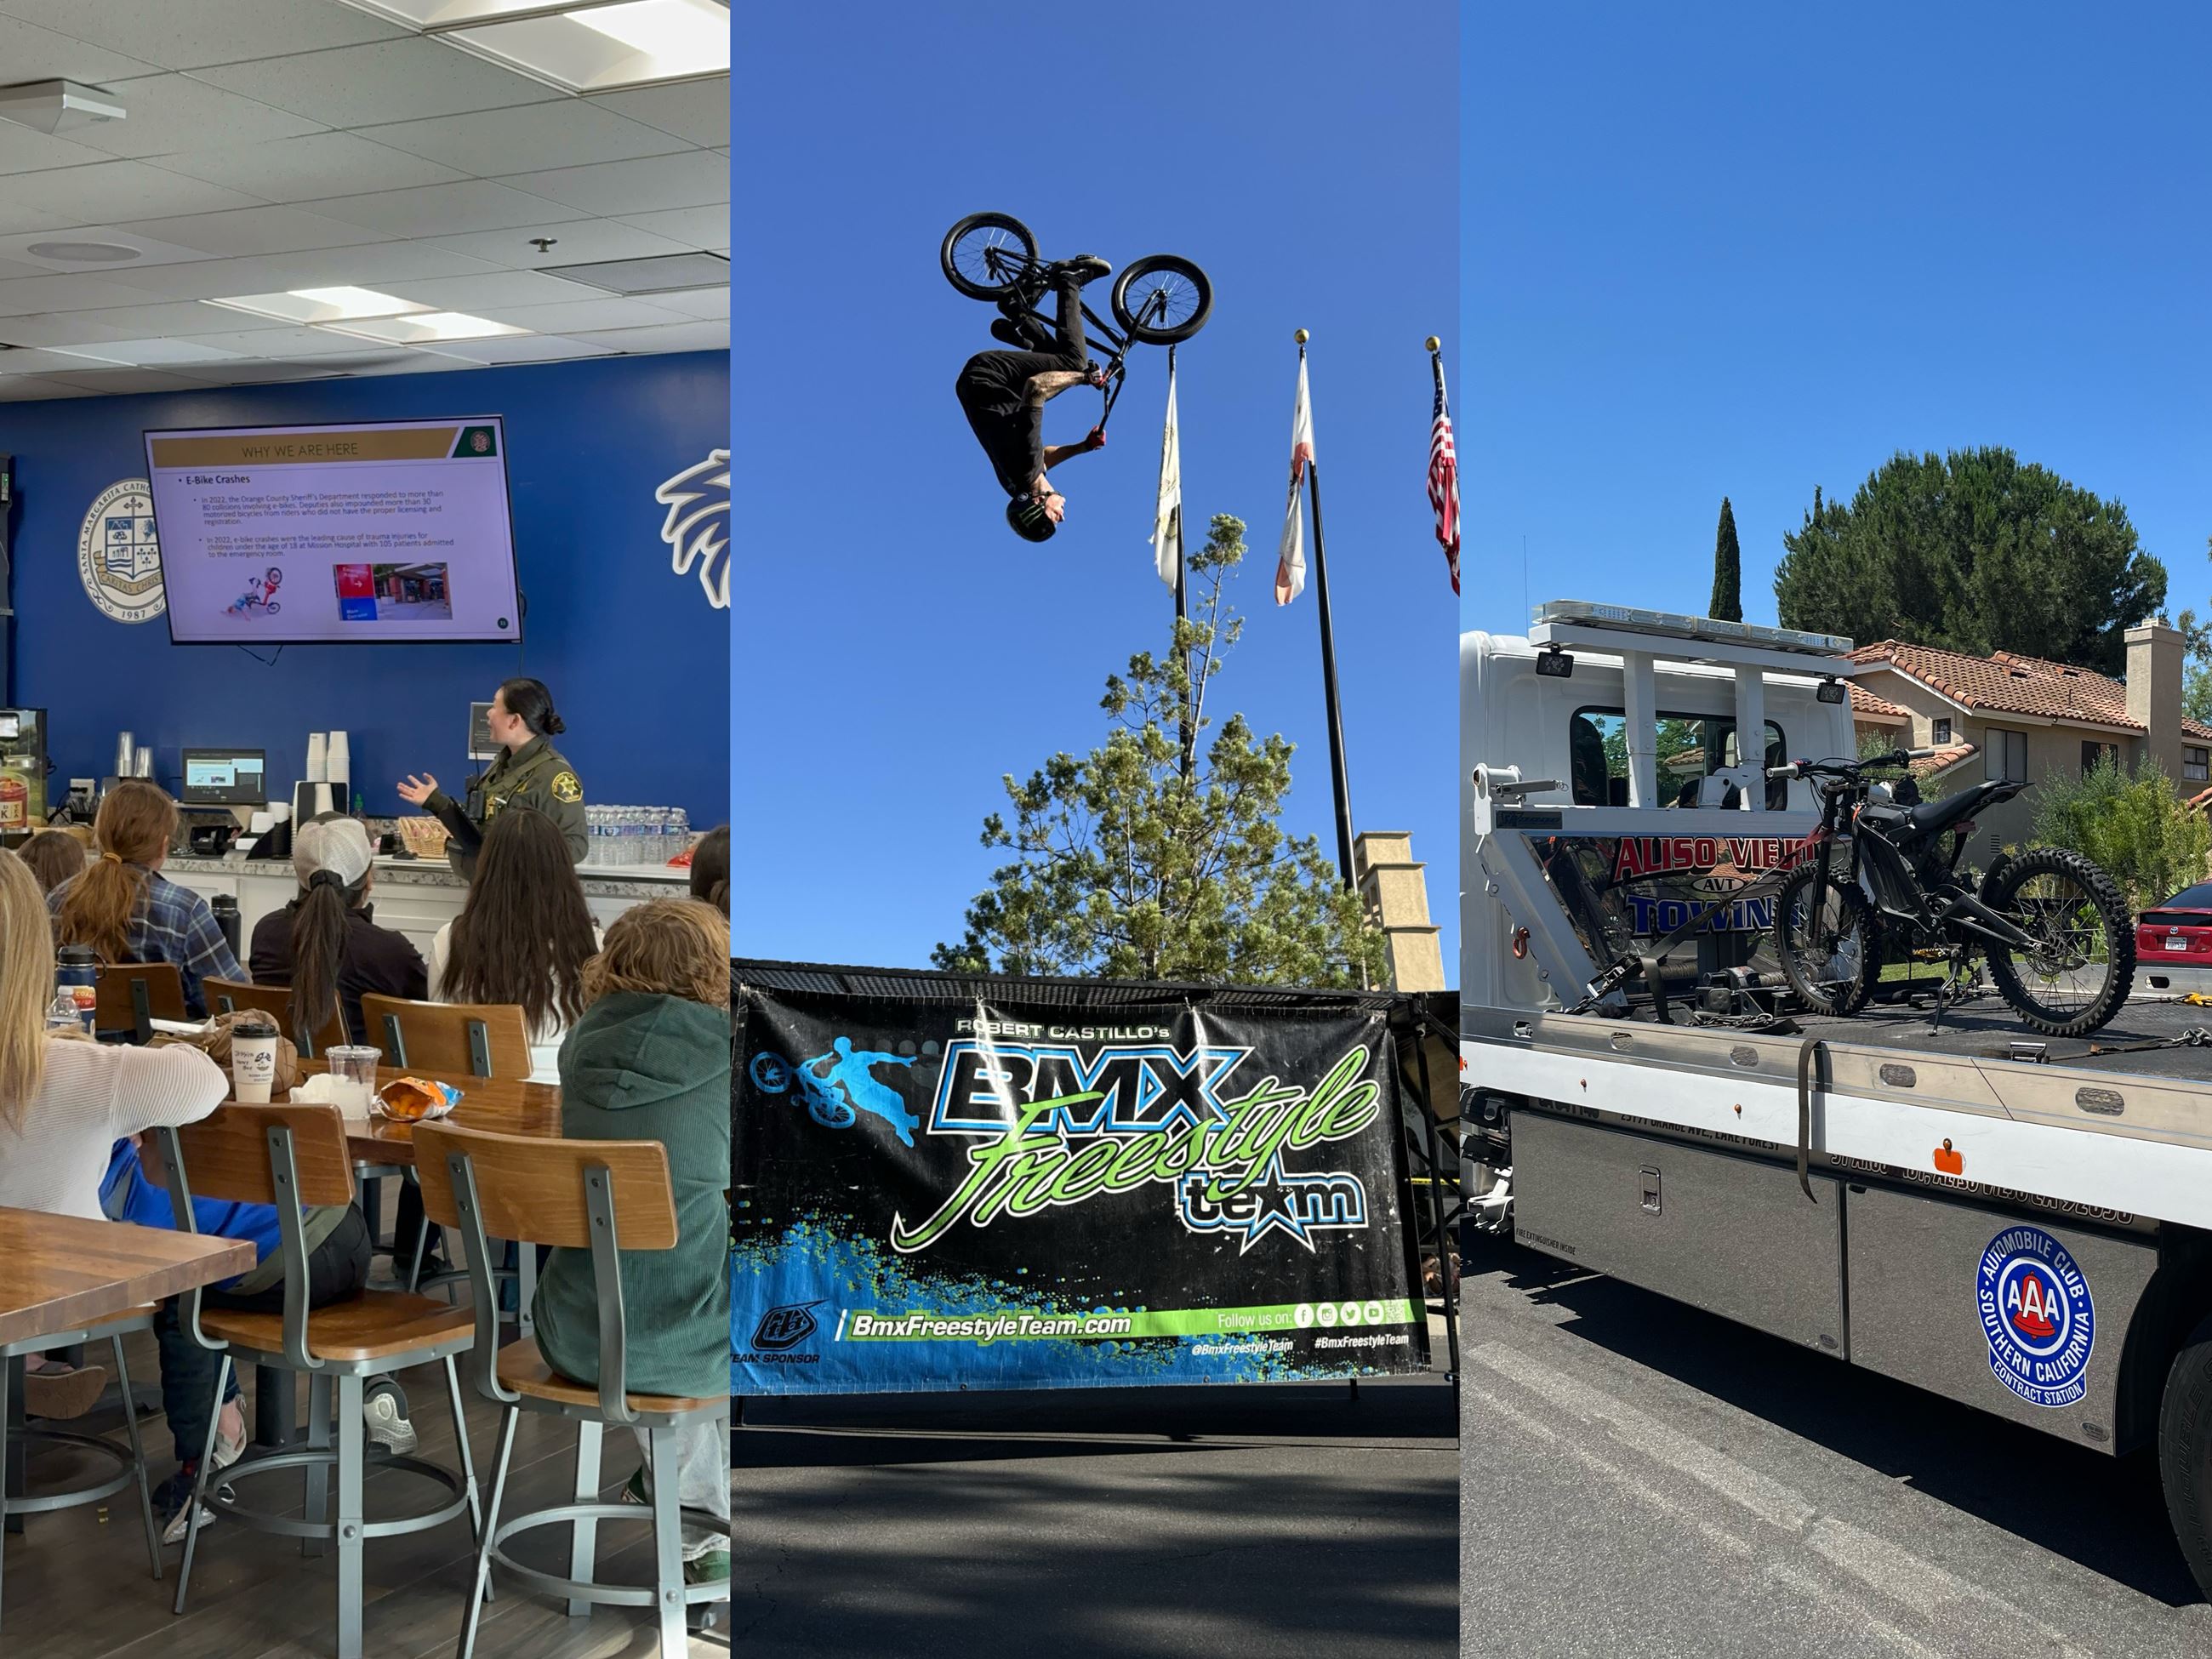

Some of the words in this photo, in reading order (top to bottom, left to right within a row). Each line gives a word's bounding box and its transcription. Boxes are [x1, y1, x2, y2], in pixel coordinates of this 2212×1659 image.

[242, 446, 271, 458] WHY
[274, 445, 294, 457] WE
[299, 444, 322, 456] ARE
[326, 442, 358, 455] HERE
[185, 476, 214, 485] E-Bike
[215, 475, 250, 484] Crashes
[241, 495, 265, 505] Orange
[265, 495, 289, 504] County
[290, 493, 318, 502] Sheriff's
[319, 493, 360, 502] Department
[361, 492, 397, 500] responded
[299, 501, 328, 510] Deputies
[83, 487, 121, 536] MARGARITA
[237, 510, 263, 519] bicycles
[311, 534, 335, 543] leading
[391, 533, 417, 541] injuries
[334, 540, 362, 549] Hospital
[394, 540, 421, 549] patients
[100, 573, 133, 593] CARITAS
[122, 610, 145, 620] 1987
[1612, 836, 1719, 884] ALISO
[1702, 878, 1736, 892] AVT
[957, 1018, 1044, 1039] ROBERT
[1049, 1024, 1171, 1040] CASTILLO's
[927, 1040, 1254, 1136] BMX
[891, 1044, 1380, 1252] Freestyle
[1516, 1227, 1526, 1239] FIRE
[1559, 1242, 1576, 1256] INSIDE
[1982, 1231, 2053, 1283] AUTOMOBILE
[2054, 1251, 2084, 1298] CLUB
[2007, 1280, 2061, 1323] AAA
[852, 1314, 1132, 1342] BmxFreestyleTeam.com
[1218, 1314, 1255, 1328] Follow
[1259, 1314, 1272, 1326] us
[1275, 1313, 1293, 1325] on:
[1192, 1339, 1293, 1356] @BmxFreestyleTeam
[1314, 1334, 1409, 1349] #BmxFreestyleTeam
[1980, 1288, 2031, 1377] SOUTHERN
[2035, 1311, 2090, 1382] CALIFORNIA
[763, 1354, 820, 1364] SPONSOR
[1993, 1360, 2042, 1403] CONTRACT
[2044, 1382, 2084, 1405] STATION
